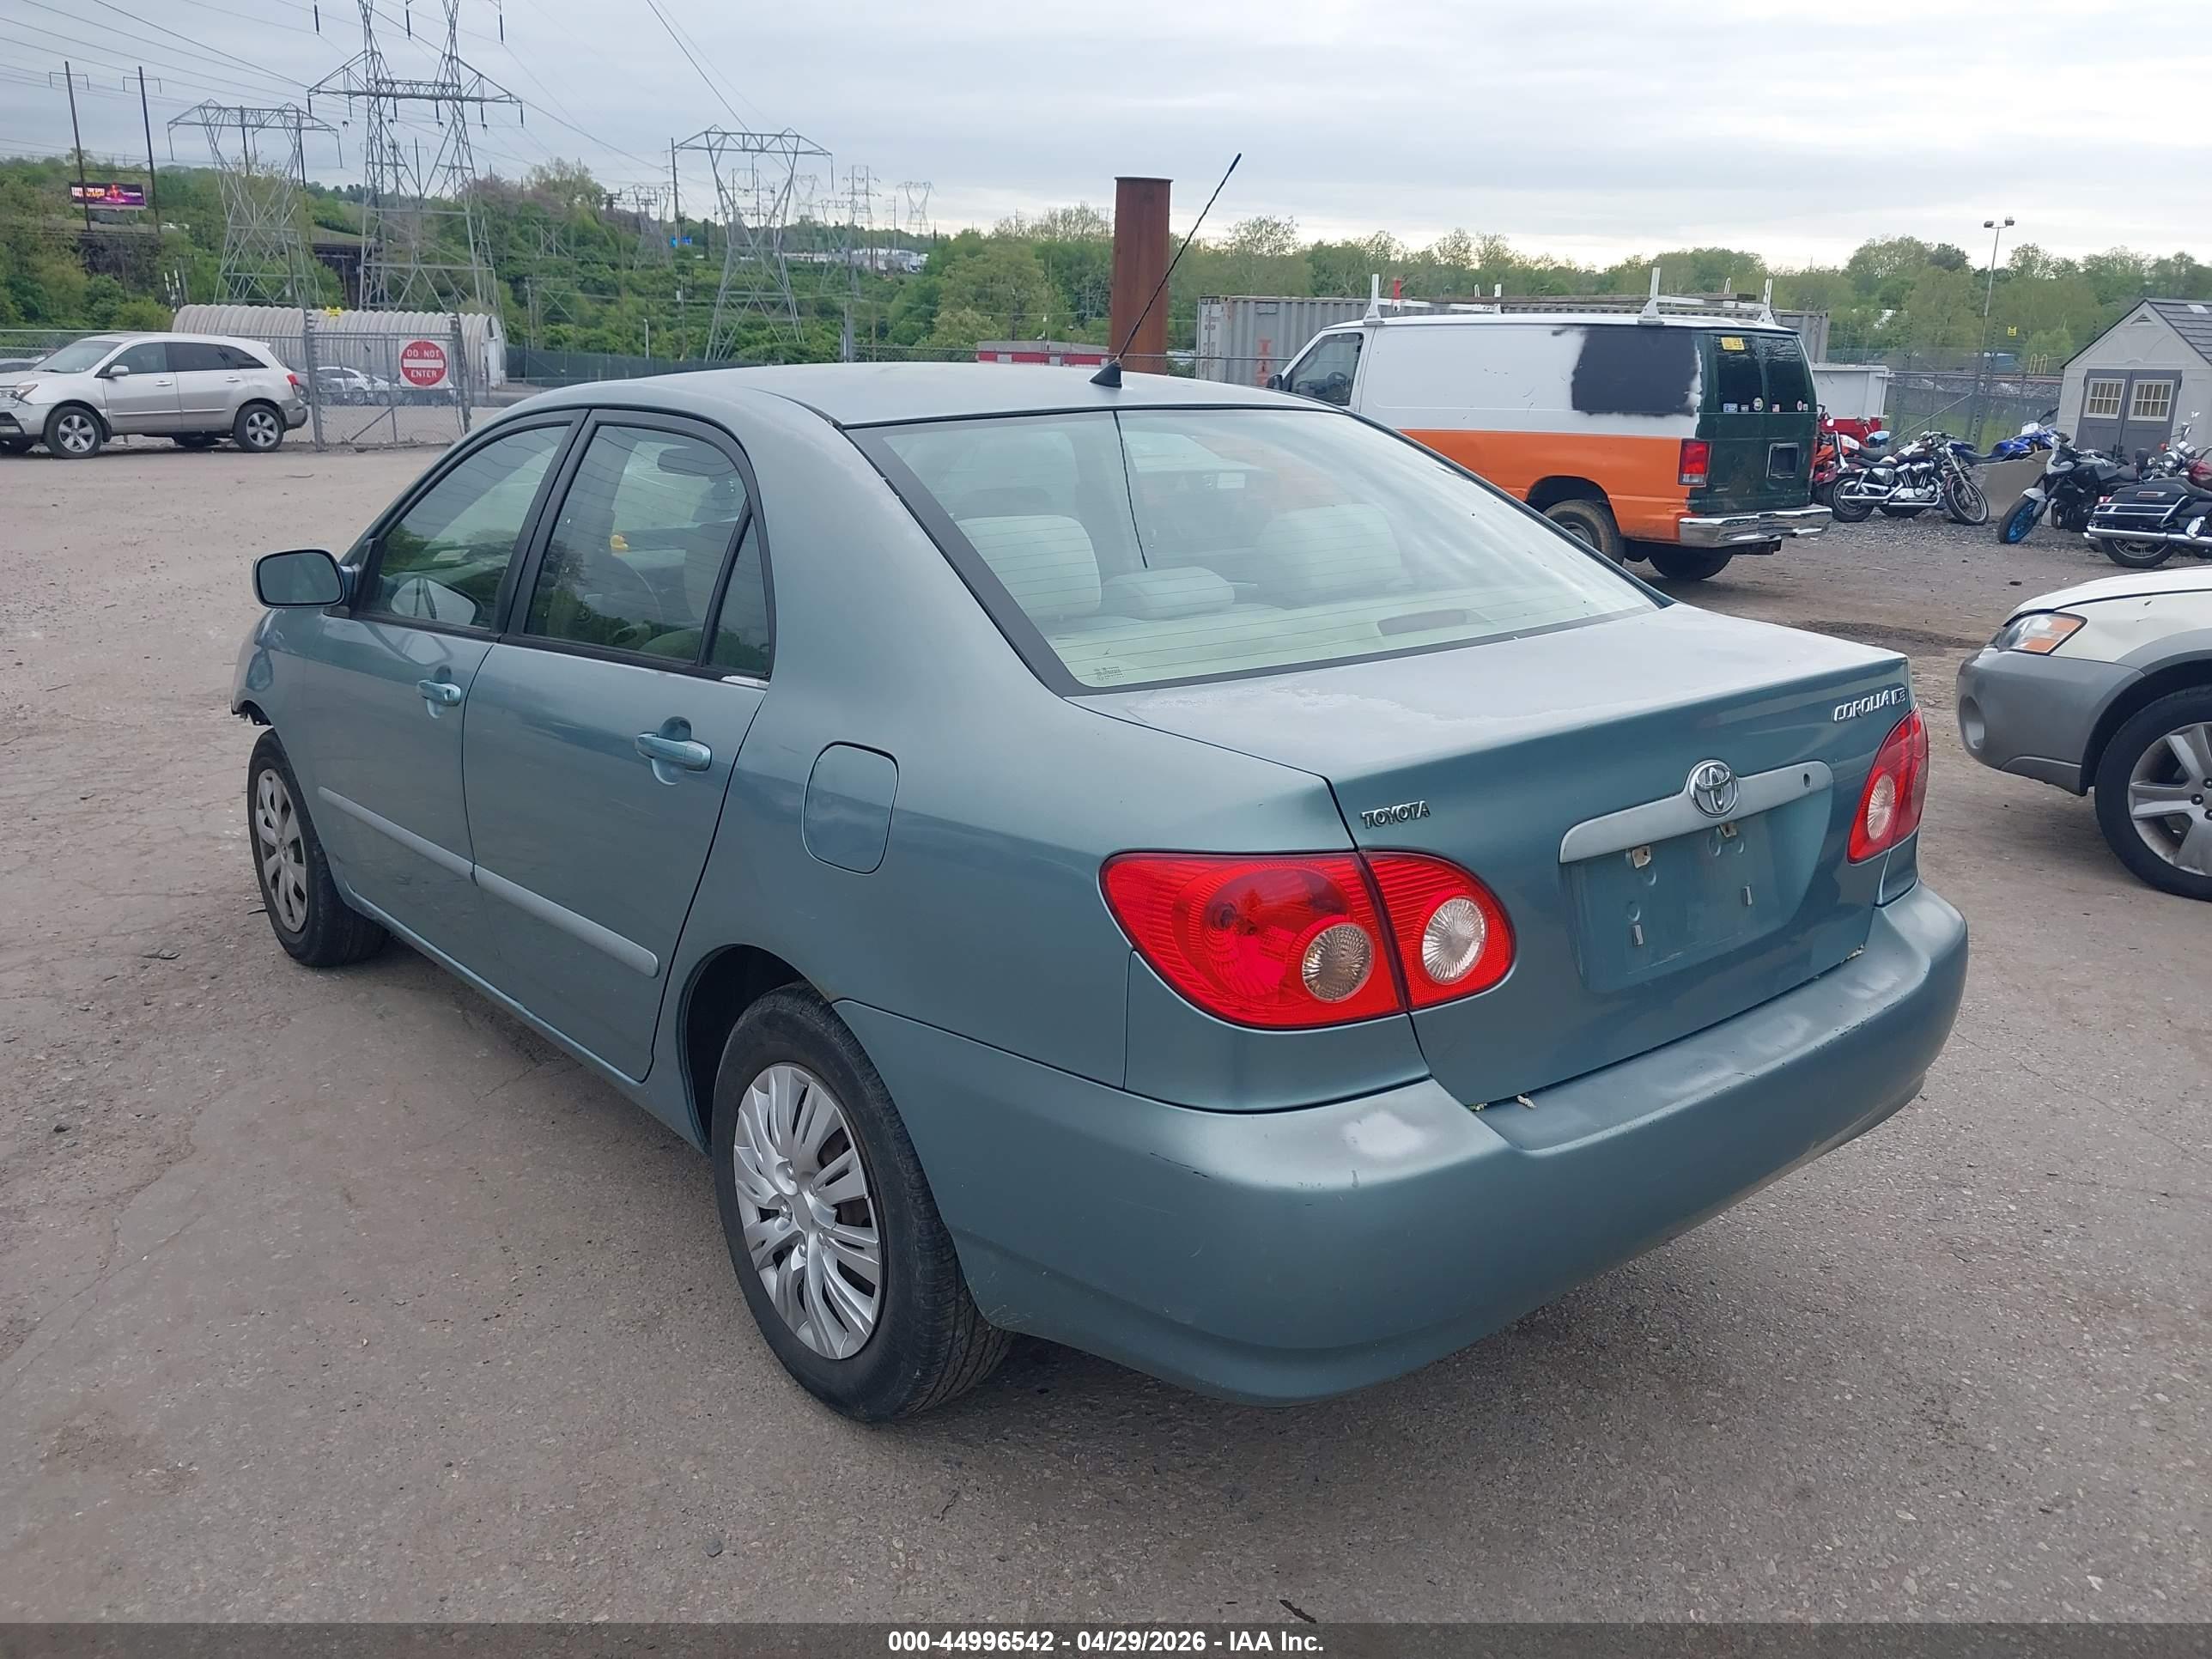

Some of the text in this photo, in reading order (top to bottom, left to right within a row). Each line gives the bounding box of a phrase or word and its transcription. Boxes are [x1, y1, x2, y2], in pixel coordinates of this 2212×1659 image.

[406, 349, 441, 358] DO NOT
[410, 369, 438, 378] ENTER
[1832, 688, 1906, 722] COROLLA LE
[1360, 799, 1431, 830] TOYOTA
